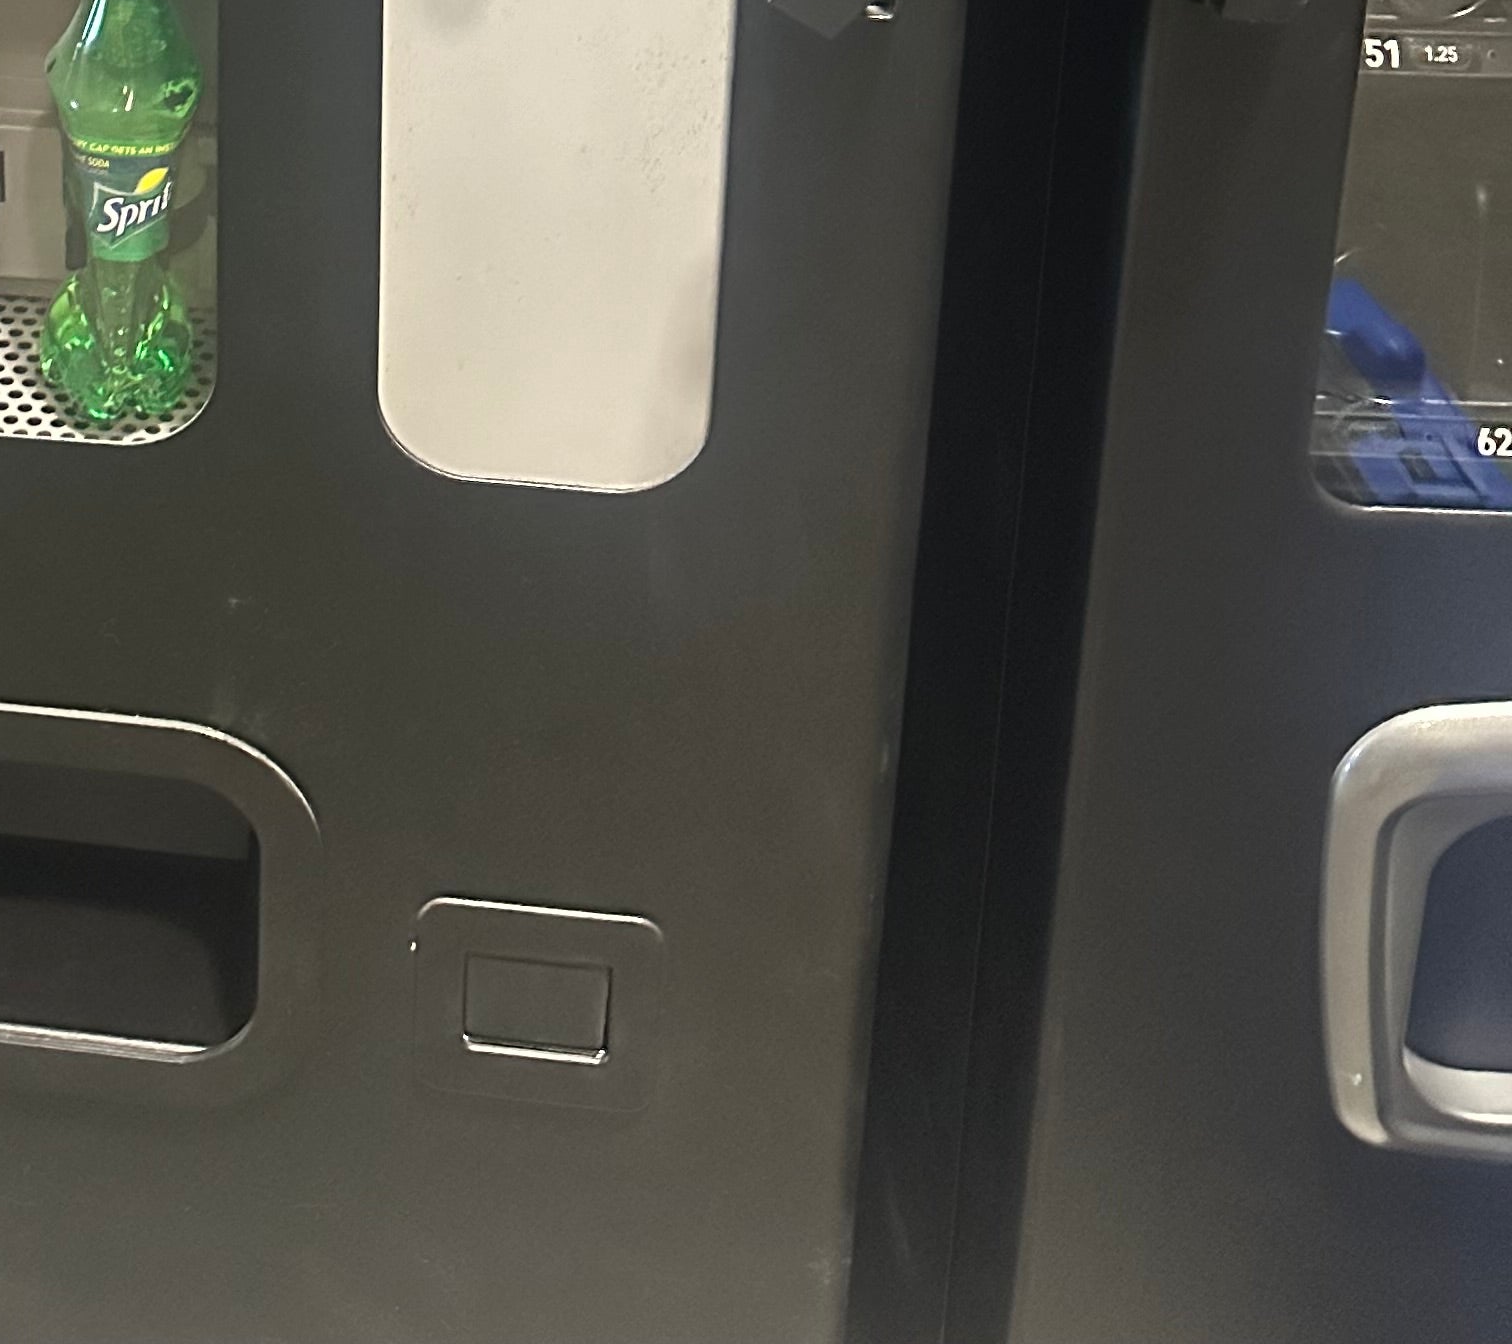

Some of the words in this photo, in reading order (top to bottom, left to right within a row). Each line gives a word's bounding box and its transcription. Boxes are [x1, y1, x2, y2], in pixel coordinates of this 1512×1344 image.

[1364, 38, 1400, 69] 51
[1424, 46, 1459, 65] 1.25
[96, 181, 173, 237] Sprit
[1477, 427, 1512, 457] 62
